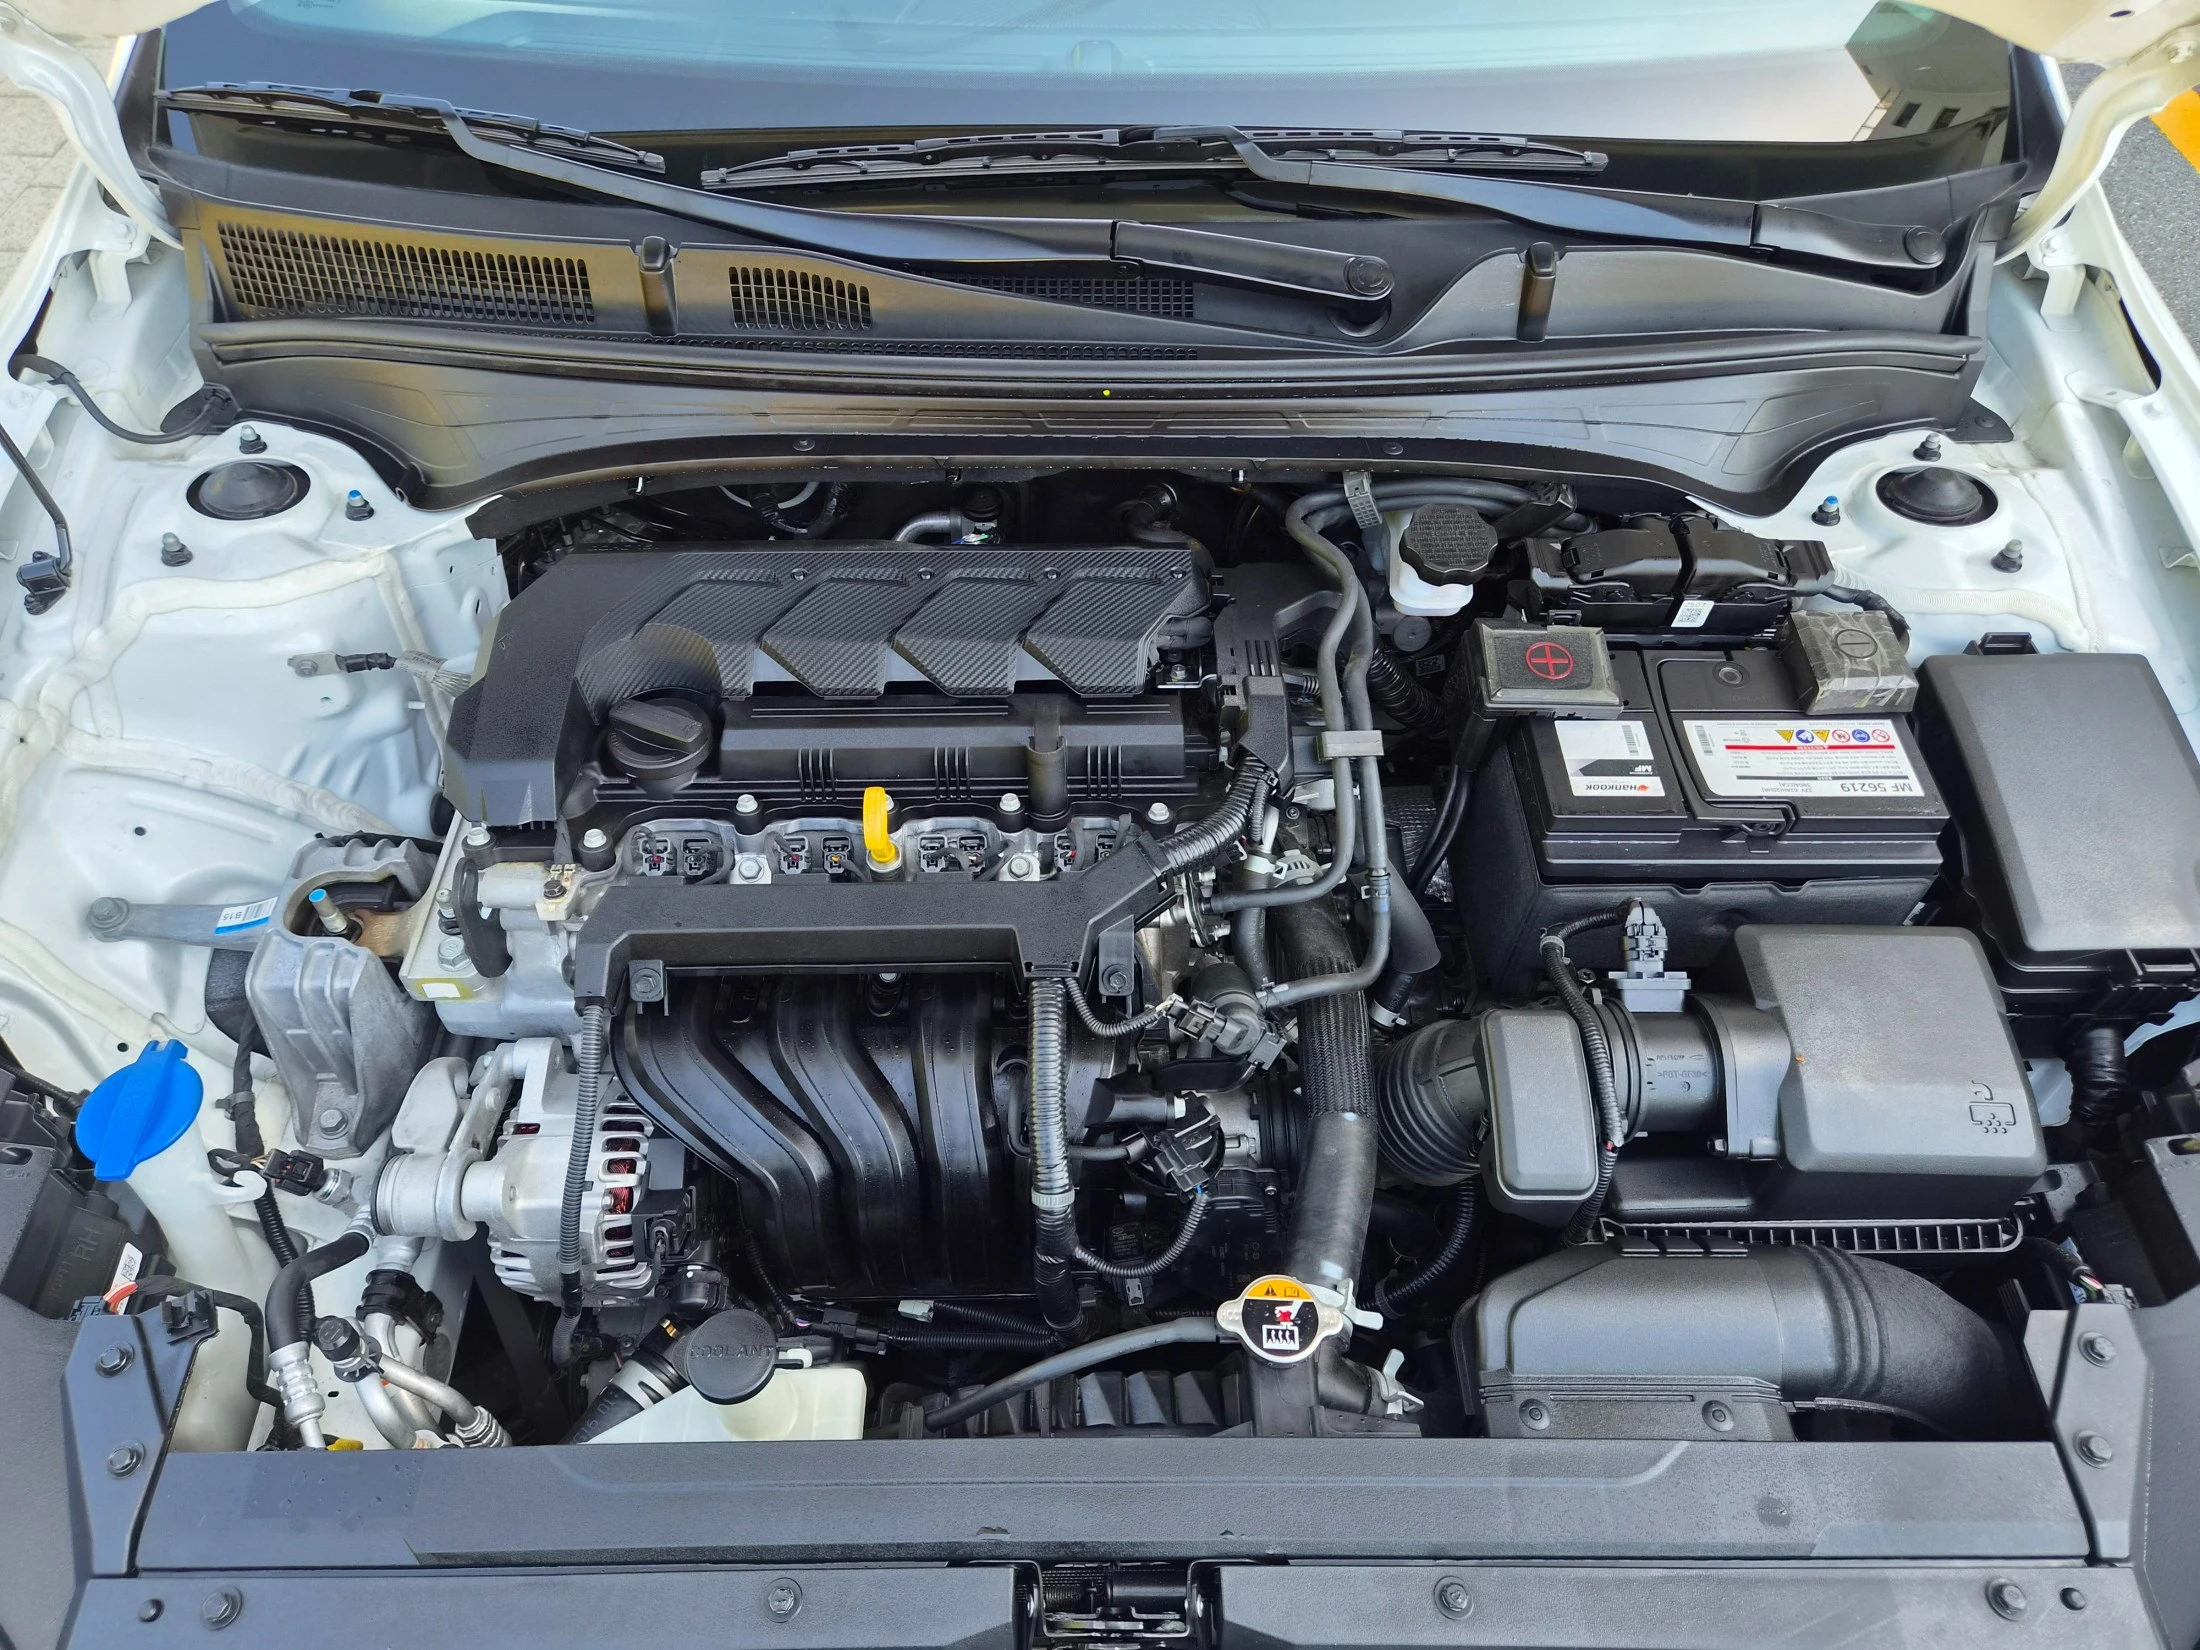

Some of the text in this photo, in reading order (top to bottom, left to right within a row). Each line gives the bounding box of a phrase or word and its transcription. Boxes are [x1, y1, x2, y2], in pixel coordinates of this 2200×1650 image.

[1634, 764, 1652, 772] MF
[1840, 783, 1913, 793] MF 56219
[223, 911, 243, 921] B15
[690, 1342, 776, 1358] COOLANT
